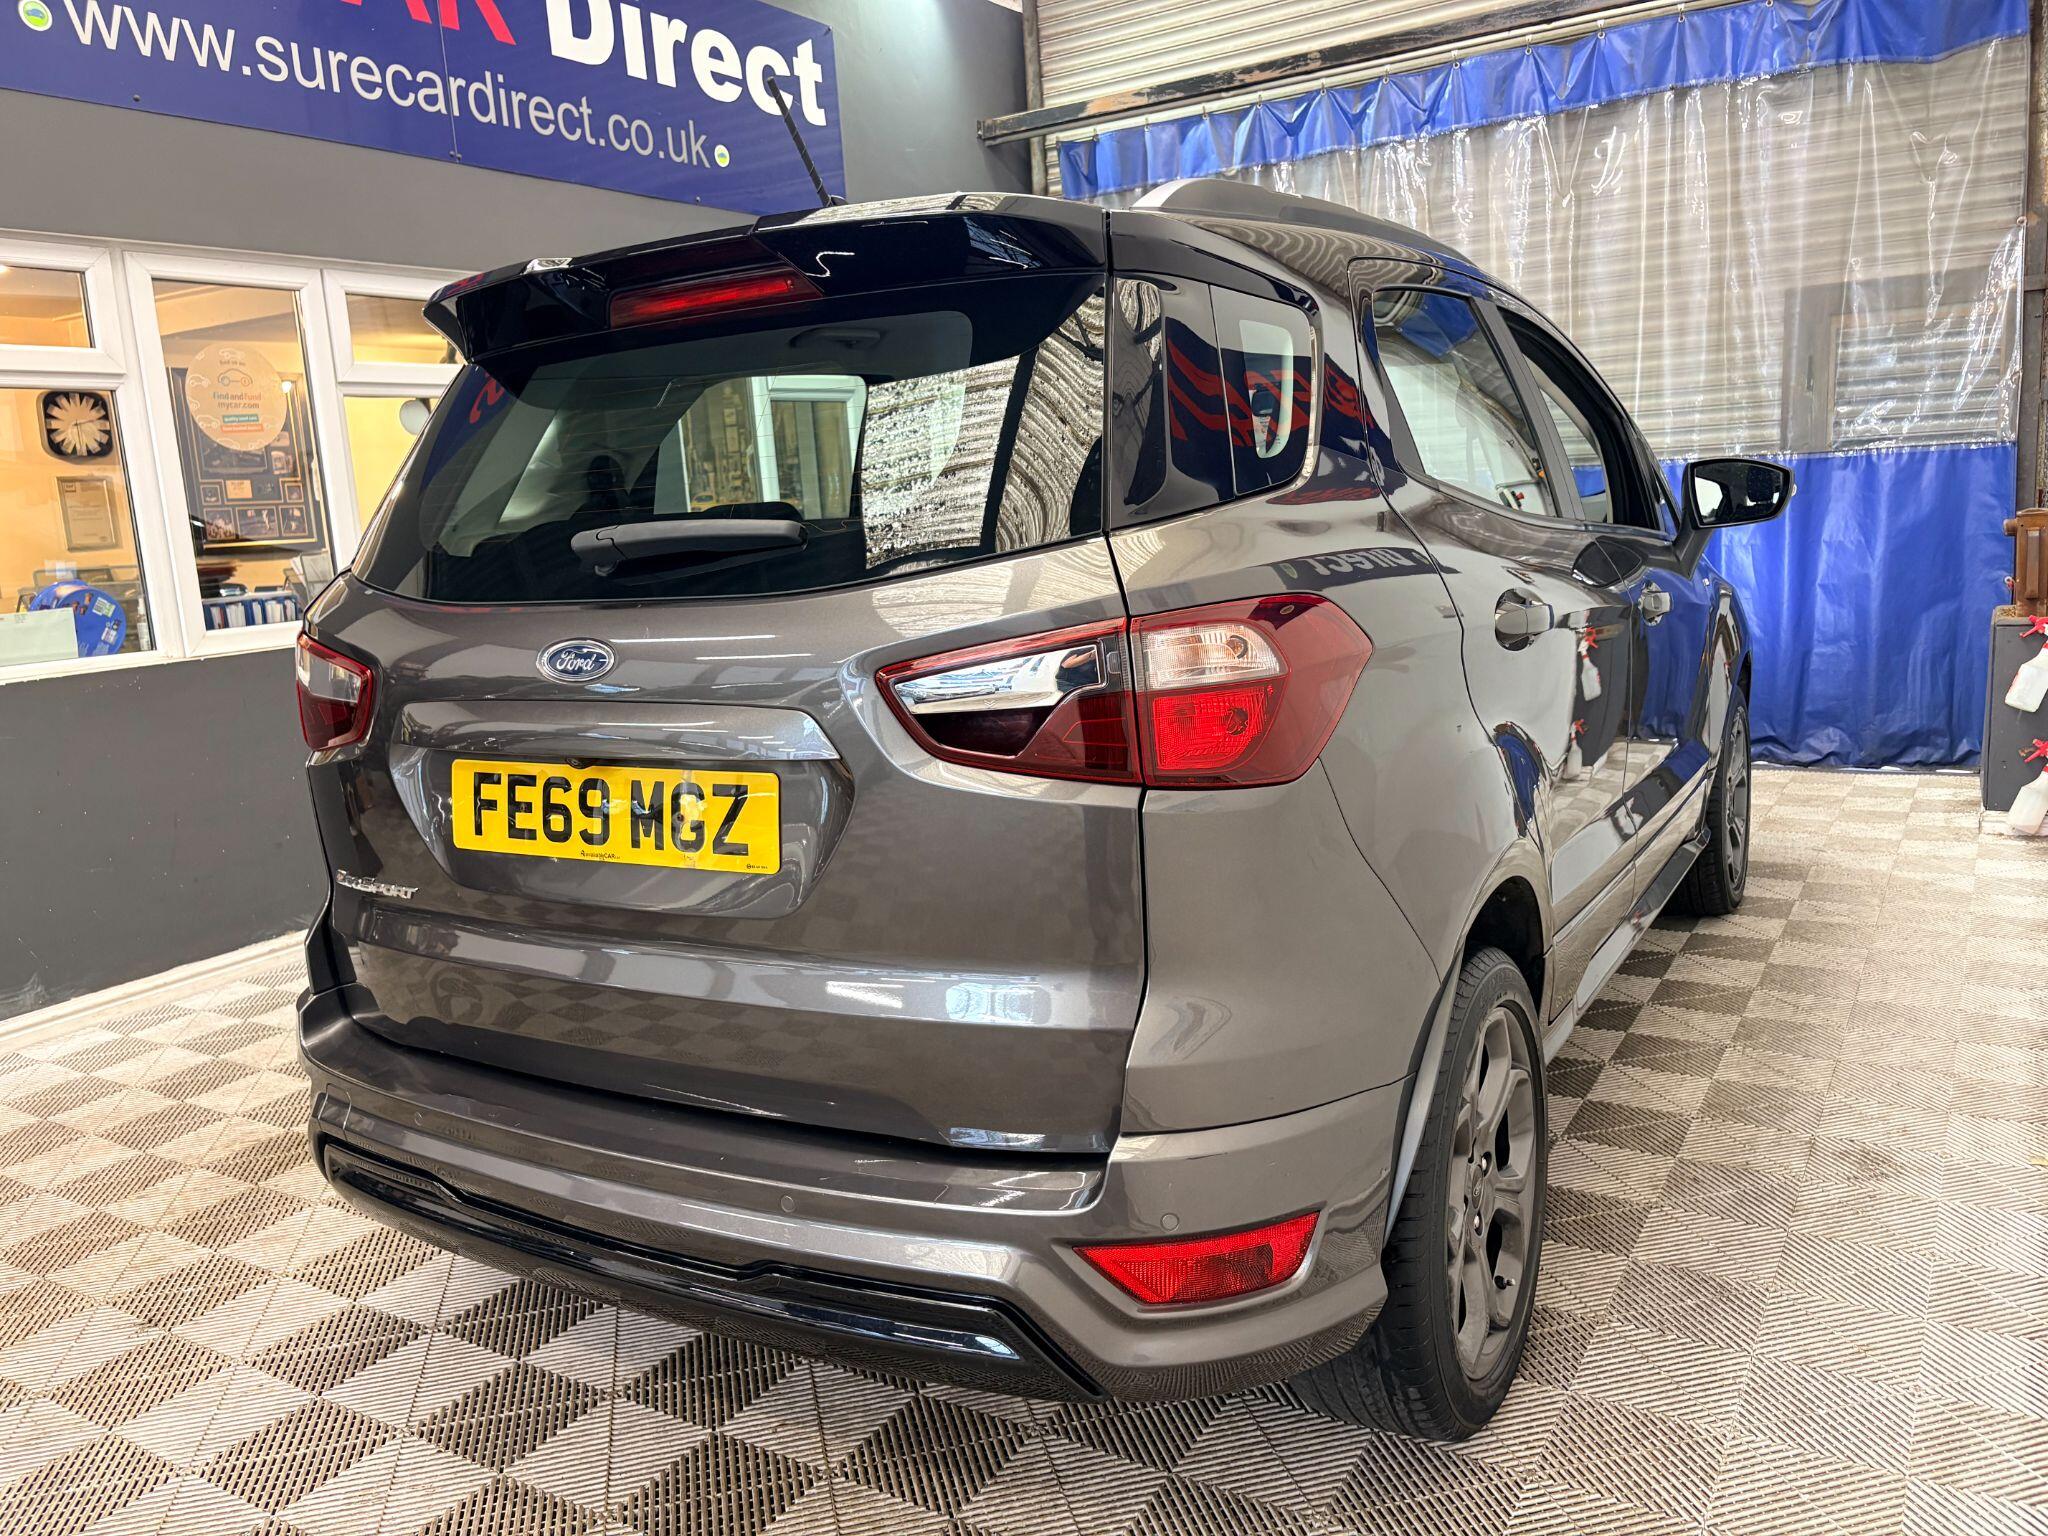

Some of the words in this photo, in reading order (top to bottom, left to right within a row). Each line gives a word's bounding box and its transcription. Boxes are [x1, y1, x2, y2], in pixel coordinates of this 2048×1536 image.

[63, 0, 711, 169] www.surecardirect.co.uk
[556, 649, 598, 671] Ford
[473, 771, 611, 846] FE69
[630, 779, 749, 857] MGZ
